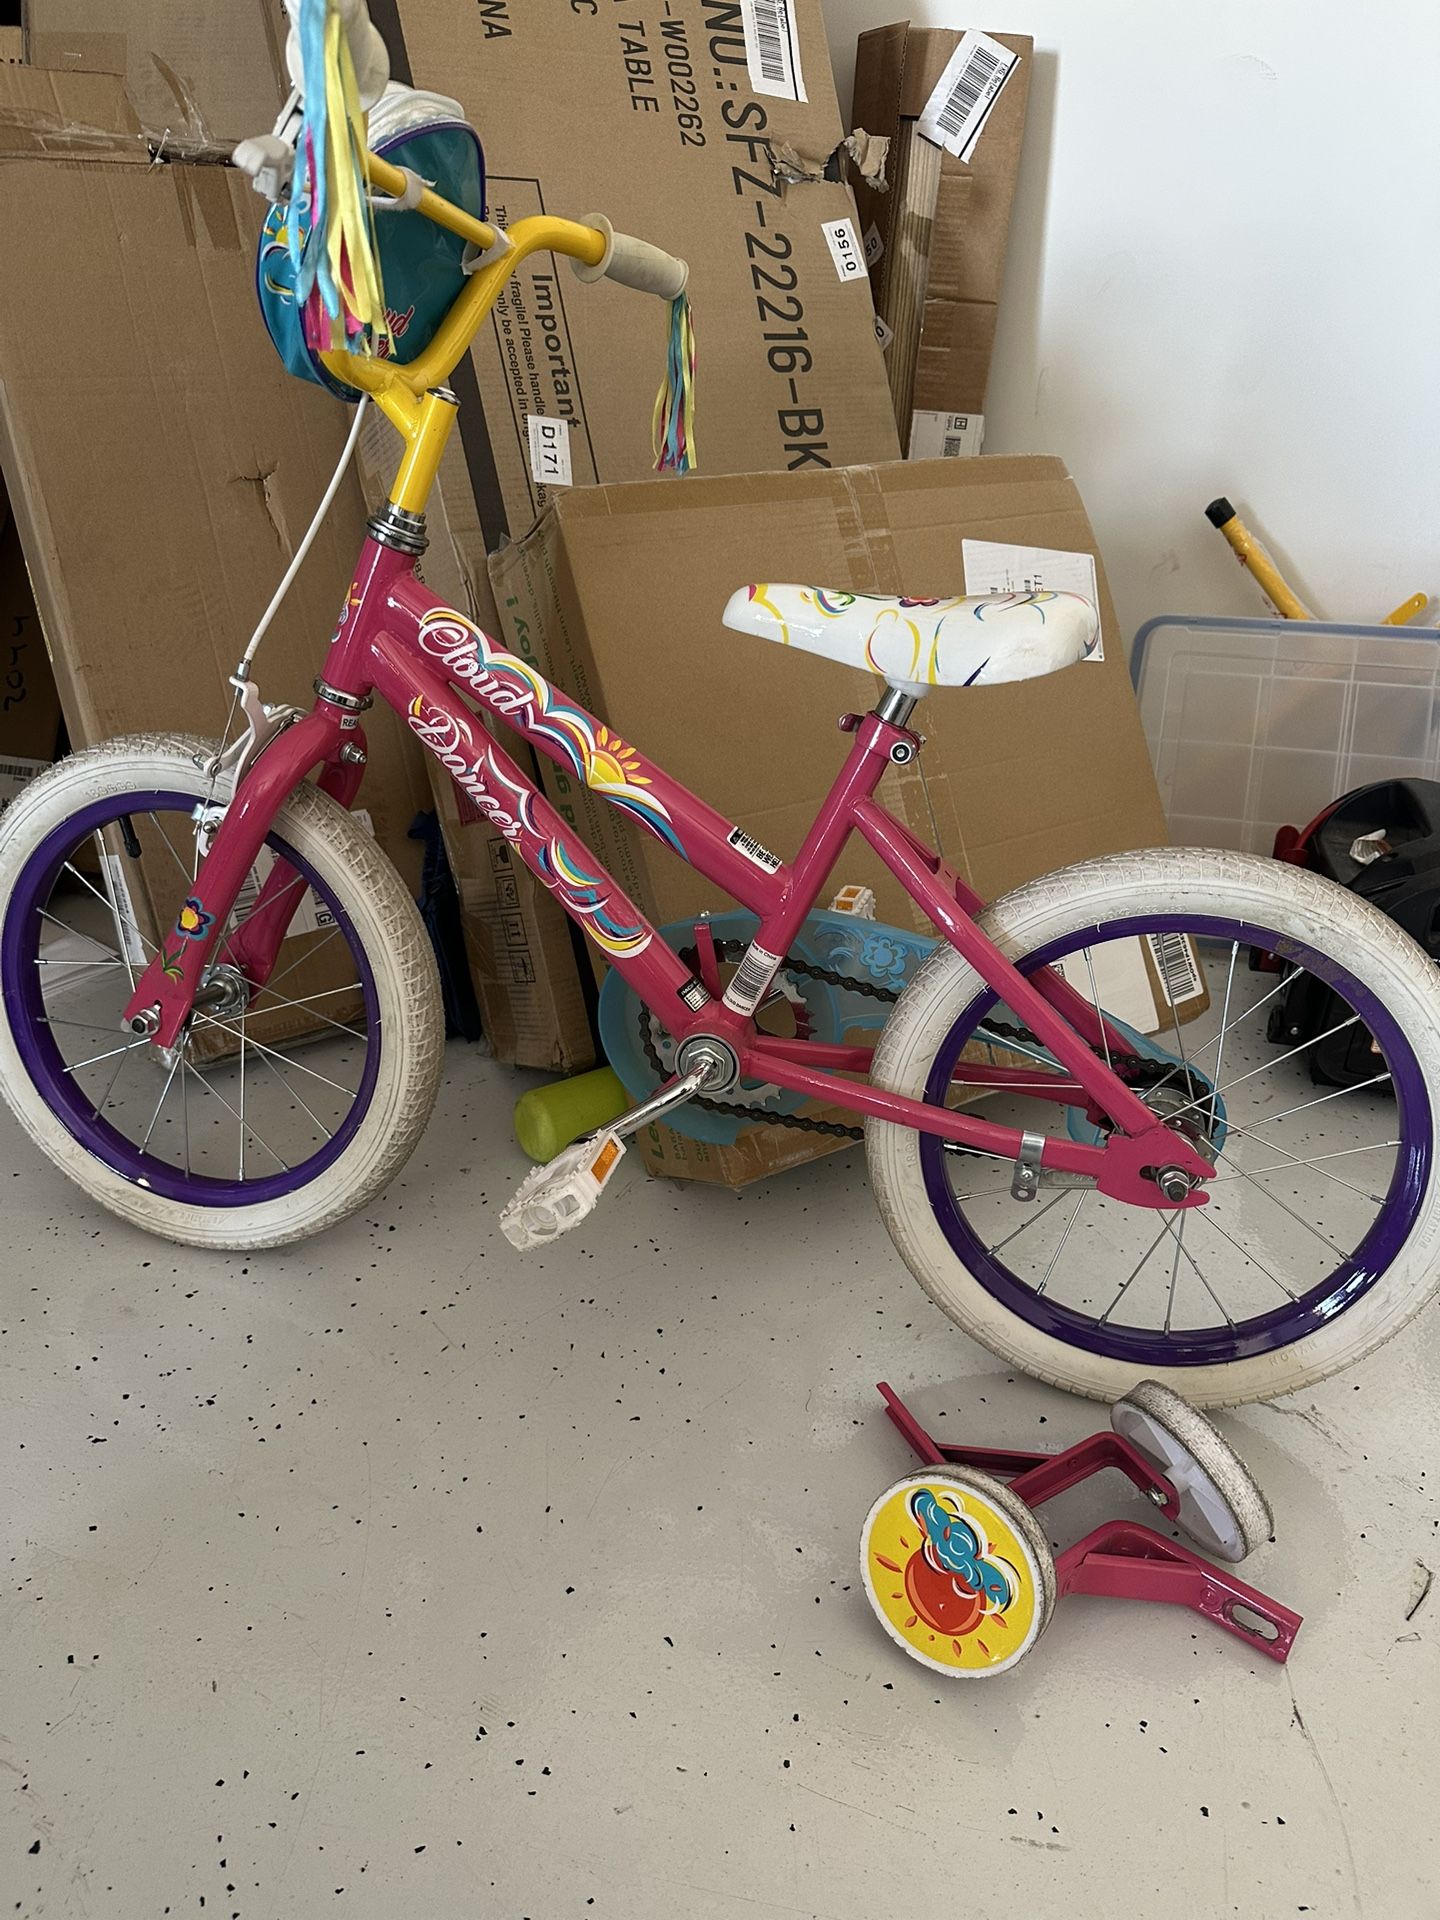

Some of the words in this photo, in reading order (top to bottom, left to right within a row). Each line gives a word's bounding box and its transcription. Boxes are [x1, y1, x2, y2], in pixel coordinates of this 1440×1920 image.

[618, 20, 660, 113] TABLE
[834, 227, 857, 273] 0156
[501, 319, 512, 335] be
[531, 273, 581, 428] Important
[506, 337, 527, 396] accepted
[520, 328, 536, 371] Please
[529, 371, 546, 416] handle
[517, 397, 528, 411] in
[541, 424, 560, 476] D171
[418, 620, 535, 716] Cloud
[409, 705, 523, 841] Dancer
